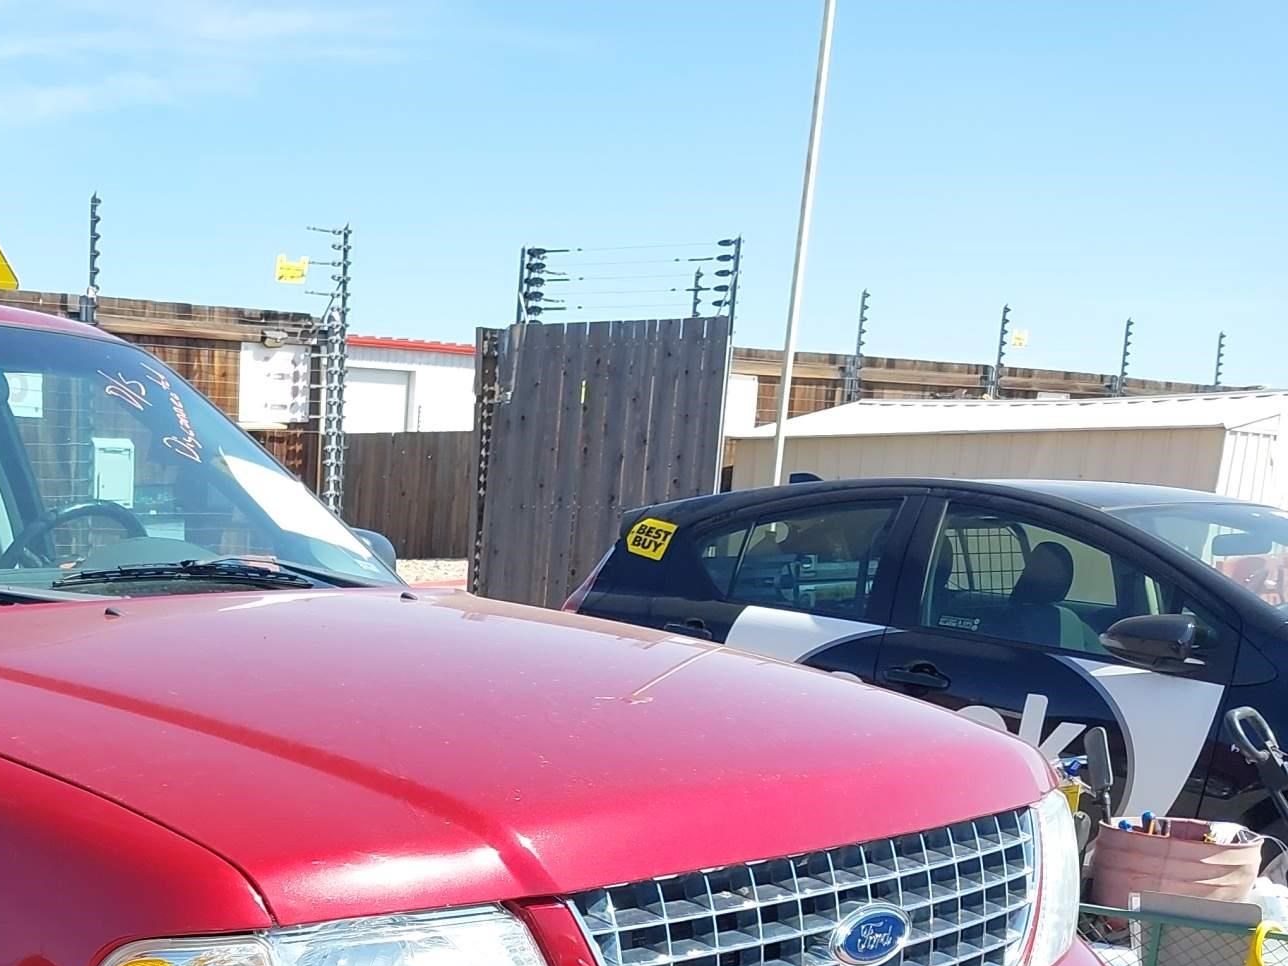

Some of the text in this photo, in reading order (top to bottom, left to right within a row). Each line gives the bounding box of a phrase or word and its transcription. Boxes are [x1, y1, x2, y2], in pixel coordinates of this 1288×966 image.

[636, 523, 672, 542] BEST
[631, 535, 665, 553] BUY
[856, 920, 894, 953] Ford
